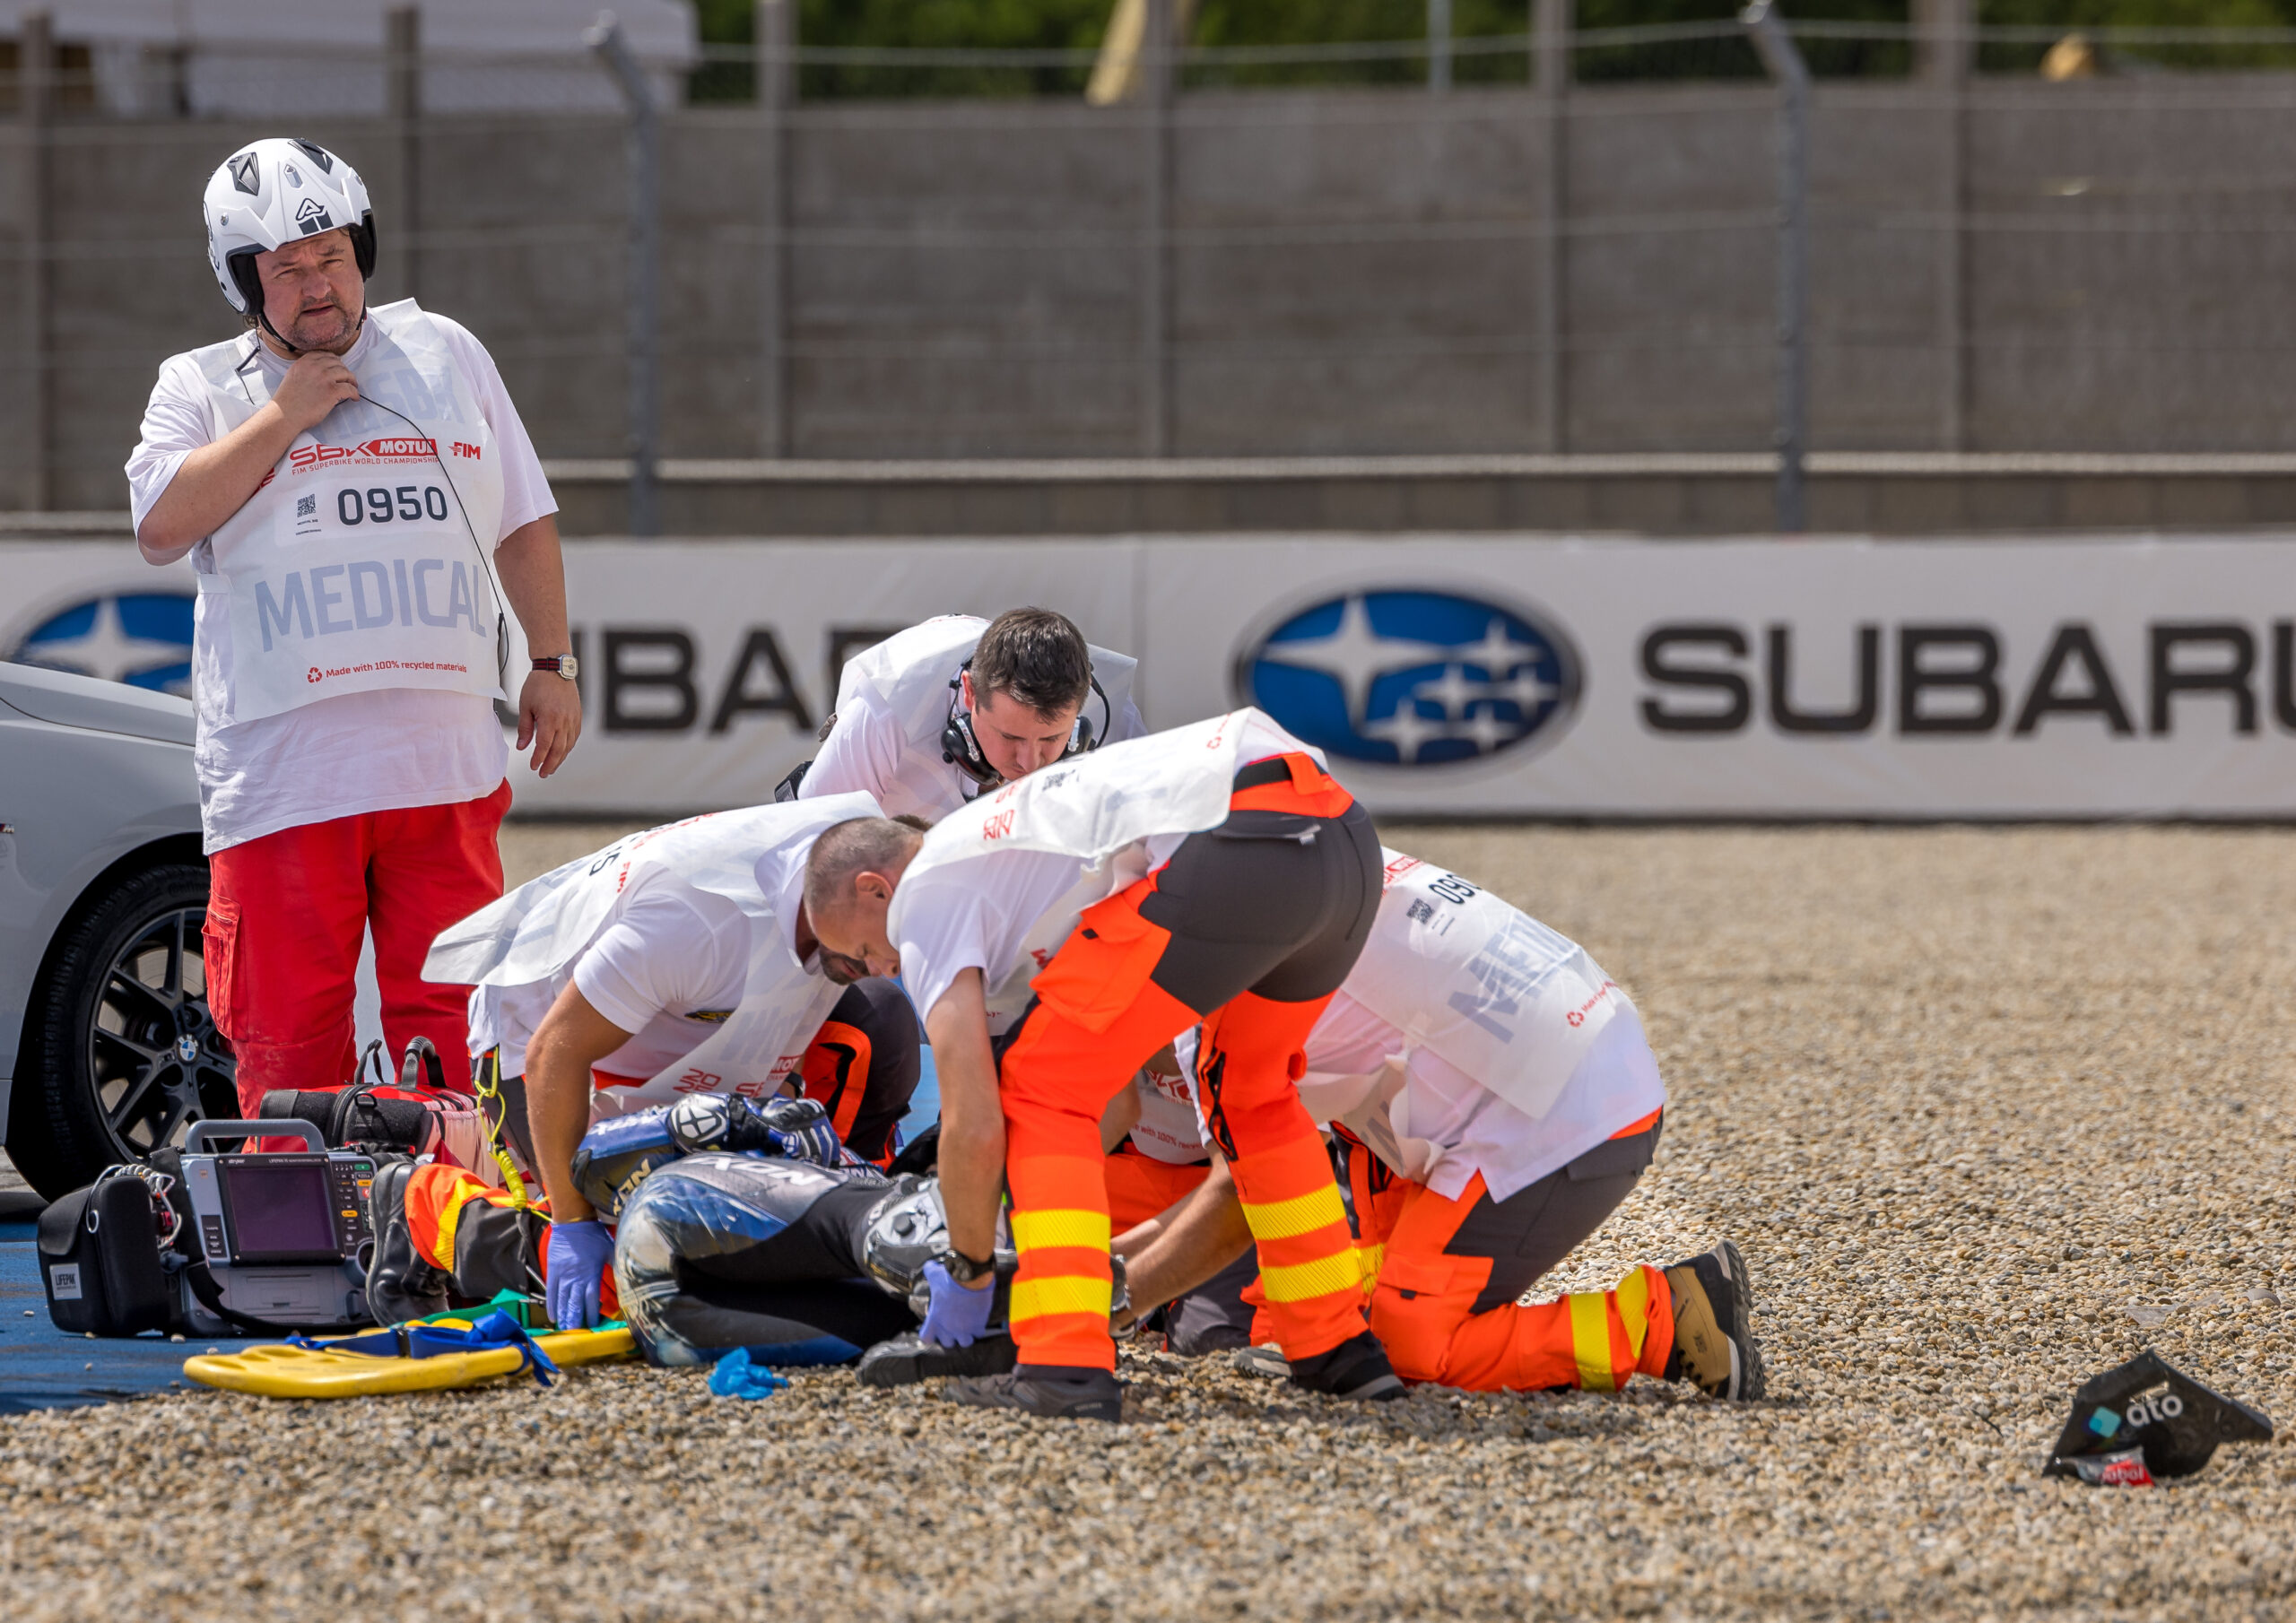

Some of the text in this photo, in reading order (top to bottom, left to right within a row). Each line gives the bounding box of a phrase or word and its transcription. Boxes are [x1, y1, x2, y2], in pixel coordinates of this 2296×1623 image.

[290, 439, 371, 467] SBK
[448, 441, 482, 460] FIM
[291, 465, 307, 475] FIM
[309, 458, 352, 472] SUPERBIKE
[383, 456, 439, 465] CHAMPIONSHIP
[337, 485, 448, 525] 0950
[254, 559, 487, 653] MEDICAL
[326, 660, 467, 678] Made with 100% recycled materials
[1639, 622, 2296, 737] SUBAR
[1140, 1125, 1157, 1137] with
[1157, 1132, 1178, 1147] 100%
[2126, 1393, 2185, 1428] ato
